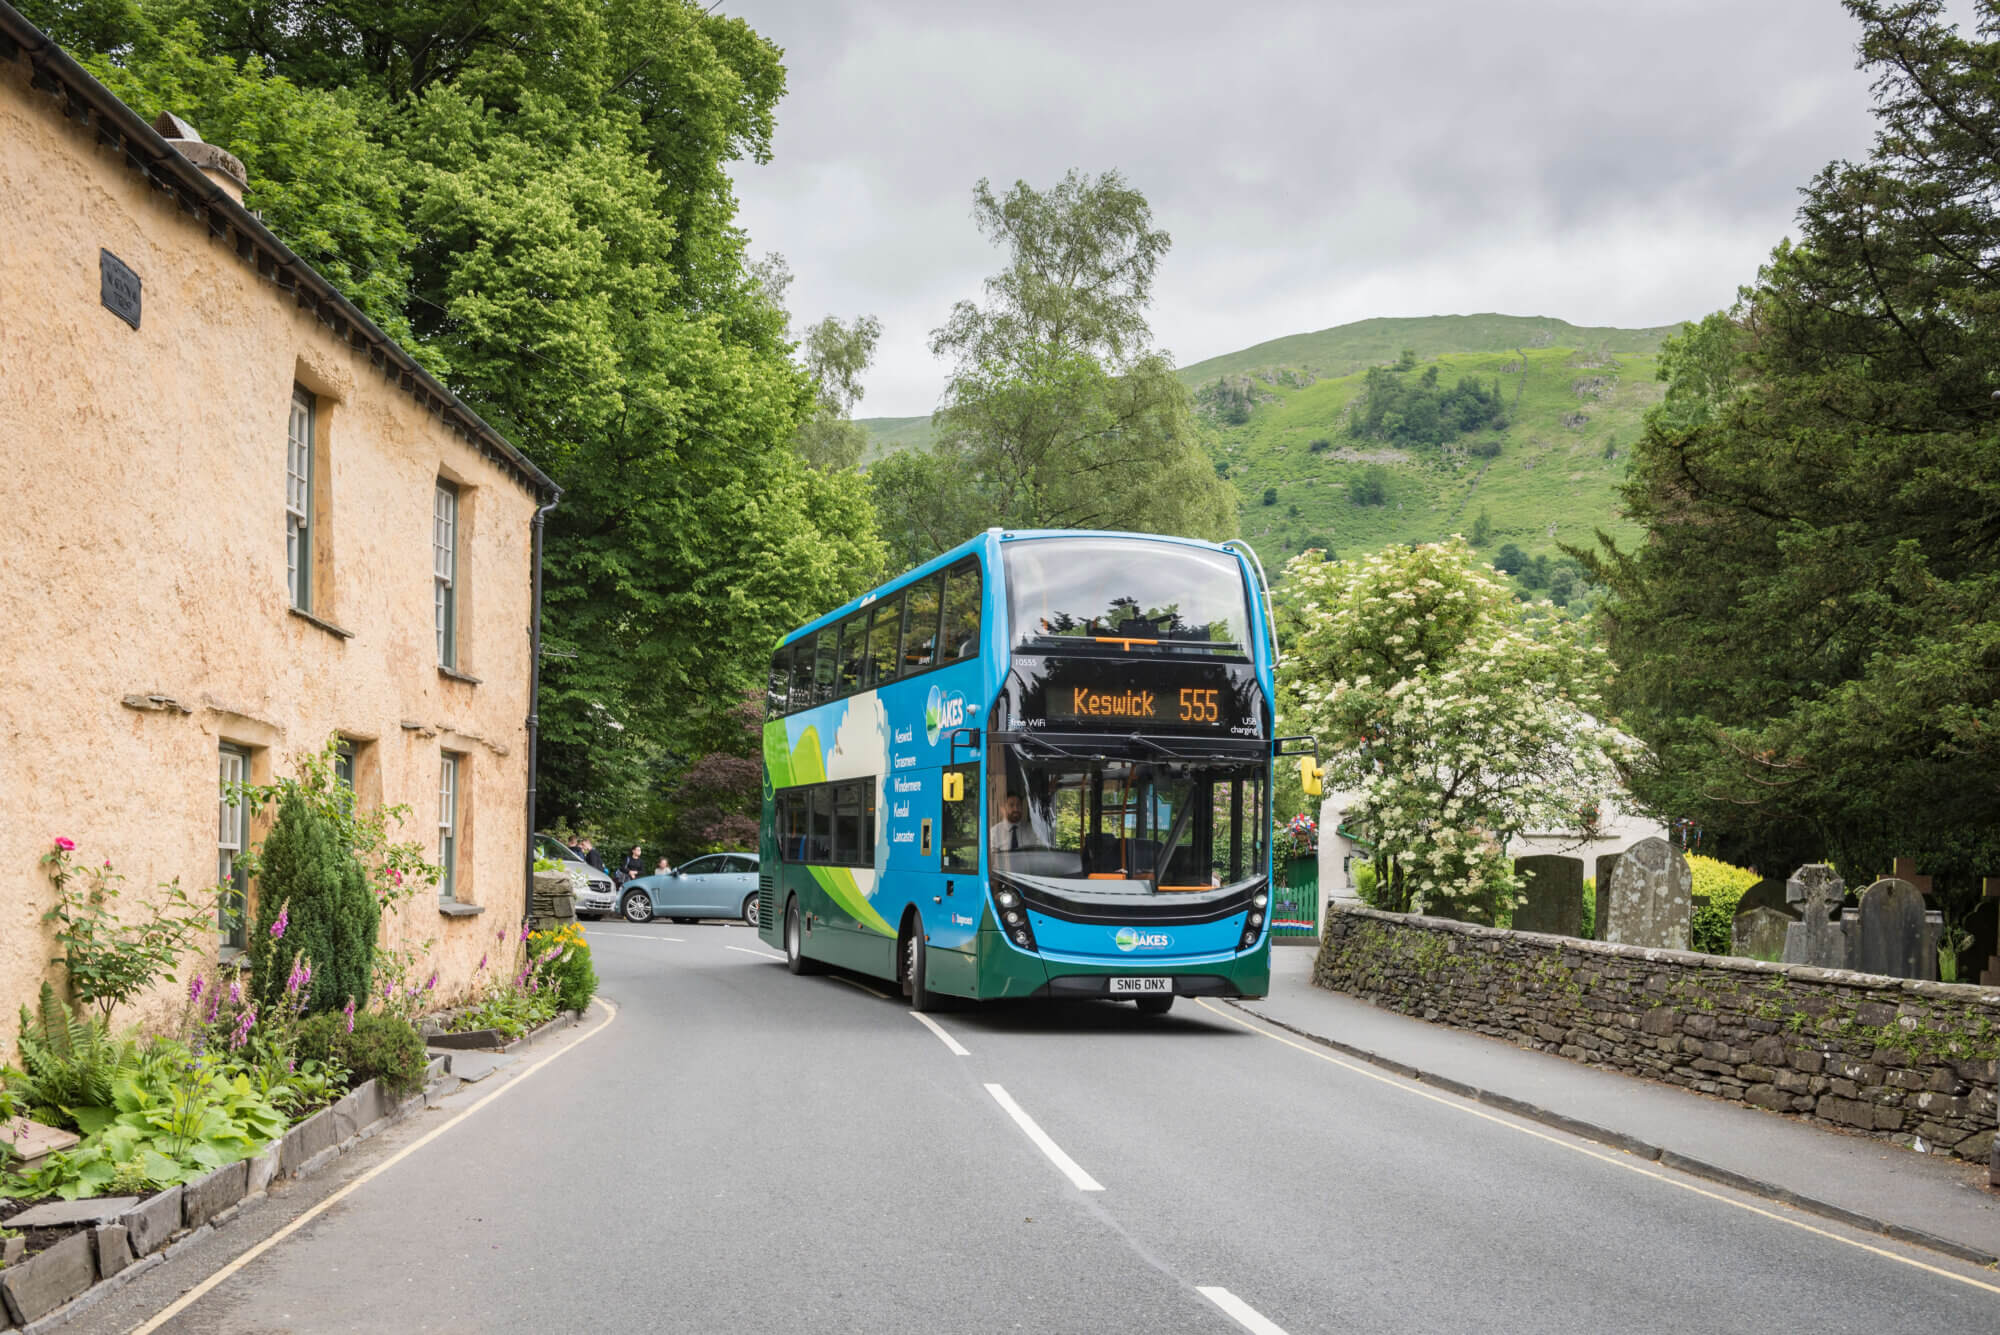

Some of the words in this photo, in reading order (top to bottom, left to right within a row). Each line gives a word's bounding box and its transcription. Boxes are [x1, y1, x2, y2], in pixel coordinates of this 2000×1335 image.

[1073, 687, 1154, 716] Keswick
[1179, 688, 1219, 721] 555
[937, 696, 963, 729] LAKES
[1027, 717, 1046, 727] WiFi
[1132, 932, 1168, 945] LAKES
[1117, 979, 1142, 990] SN16
